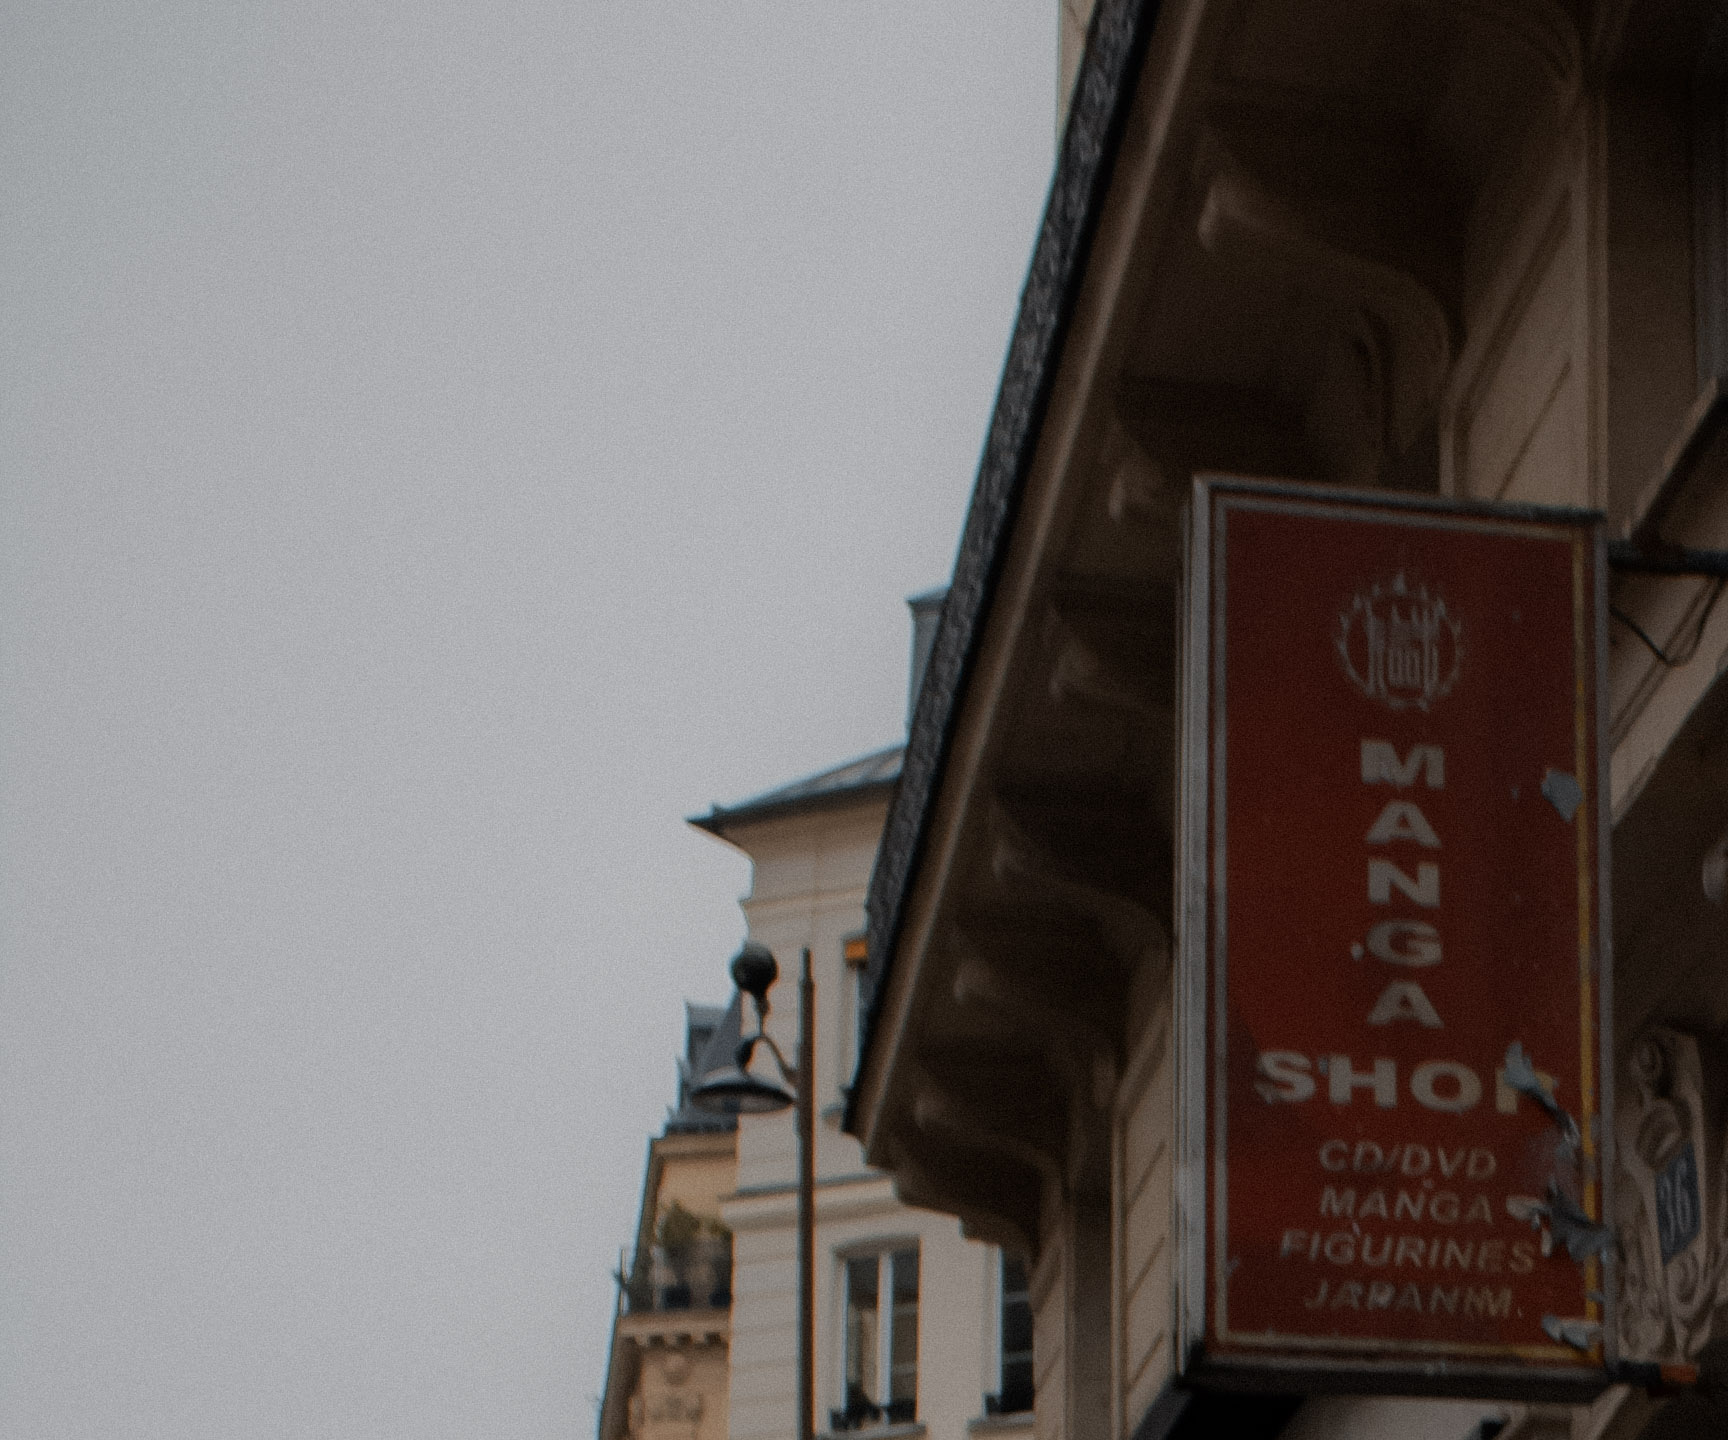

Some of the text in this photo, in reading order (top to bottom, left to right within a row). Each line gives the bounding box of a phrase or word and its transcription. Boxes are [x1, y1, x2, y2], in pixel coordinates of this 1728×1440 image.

[1318, 1139, 1497, 1181] CD/DVD
[1319, 1186, 1495, 1226] MANGA
[1280, 1229, 1536, 1275] FIGURINES
